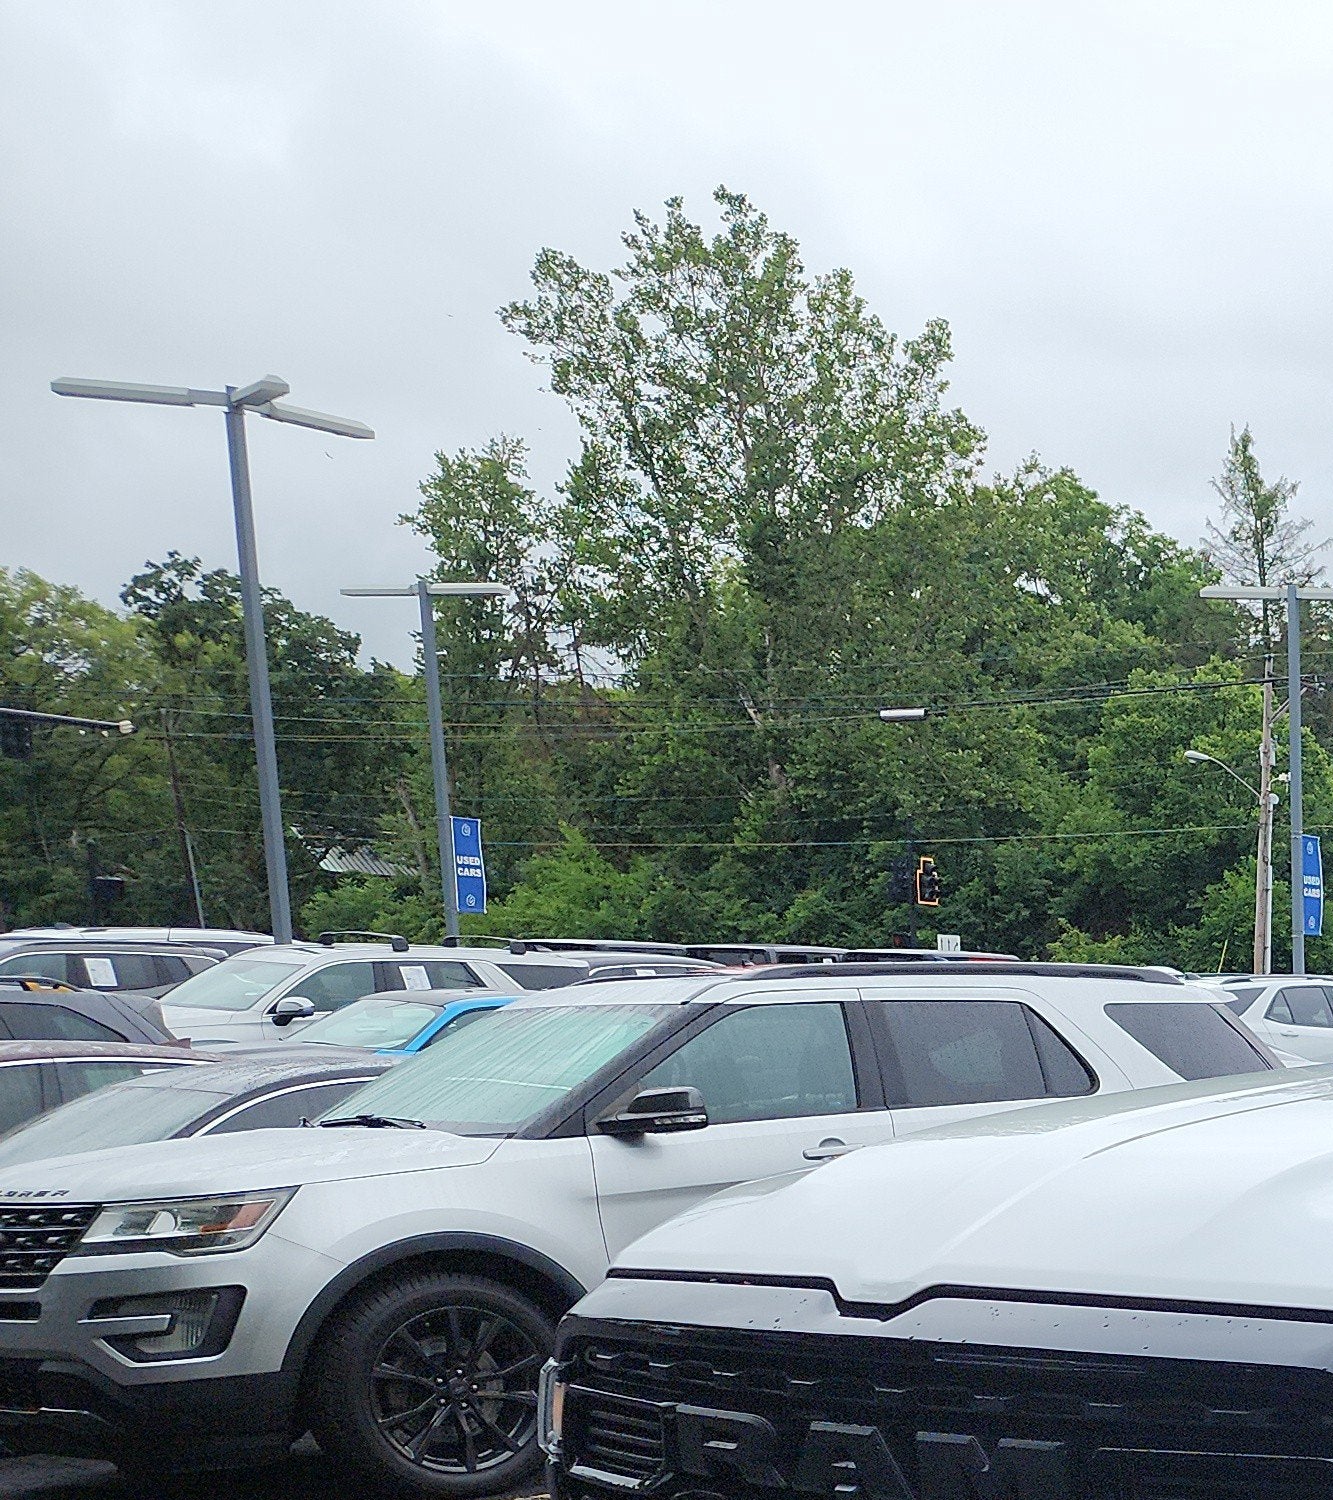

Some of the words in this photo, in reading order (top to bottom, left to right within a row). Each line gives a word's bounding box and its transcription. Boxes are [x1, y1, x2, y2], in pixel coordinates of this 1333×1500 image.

[456, 855, 481, 866] USED
[457, 867, 482, 878] CARS
[1303, 874, 1320, 886] USED
[1303, 887, 1320, 898] CARS
